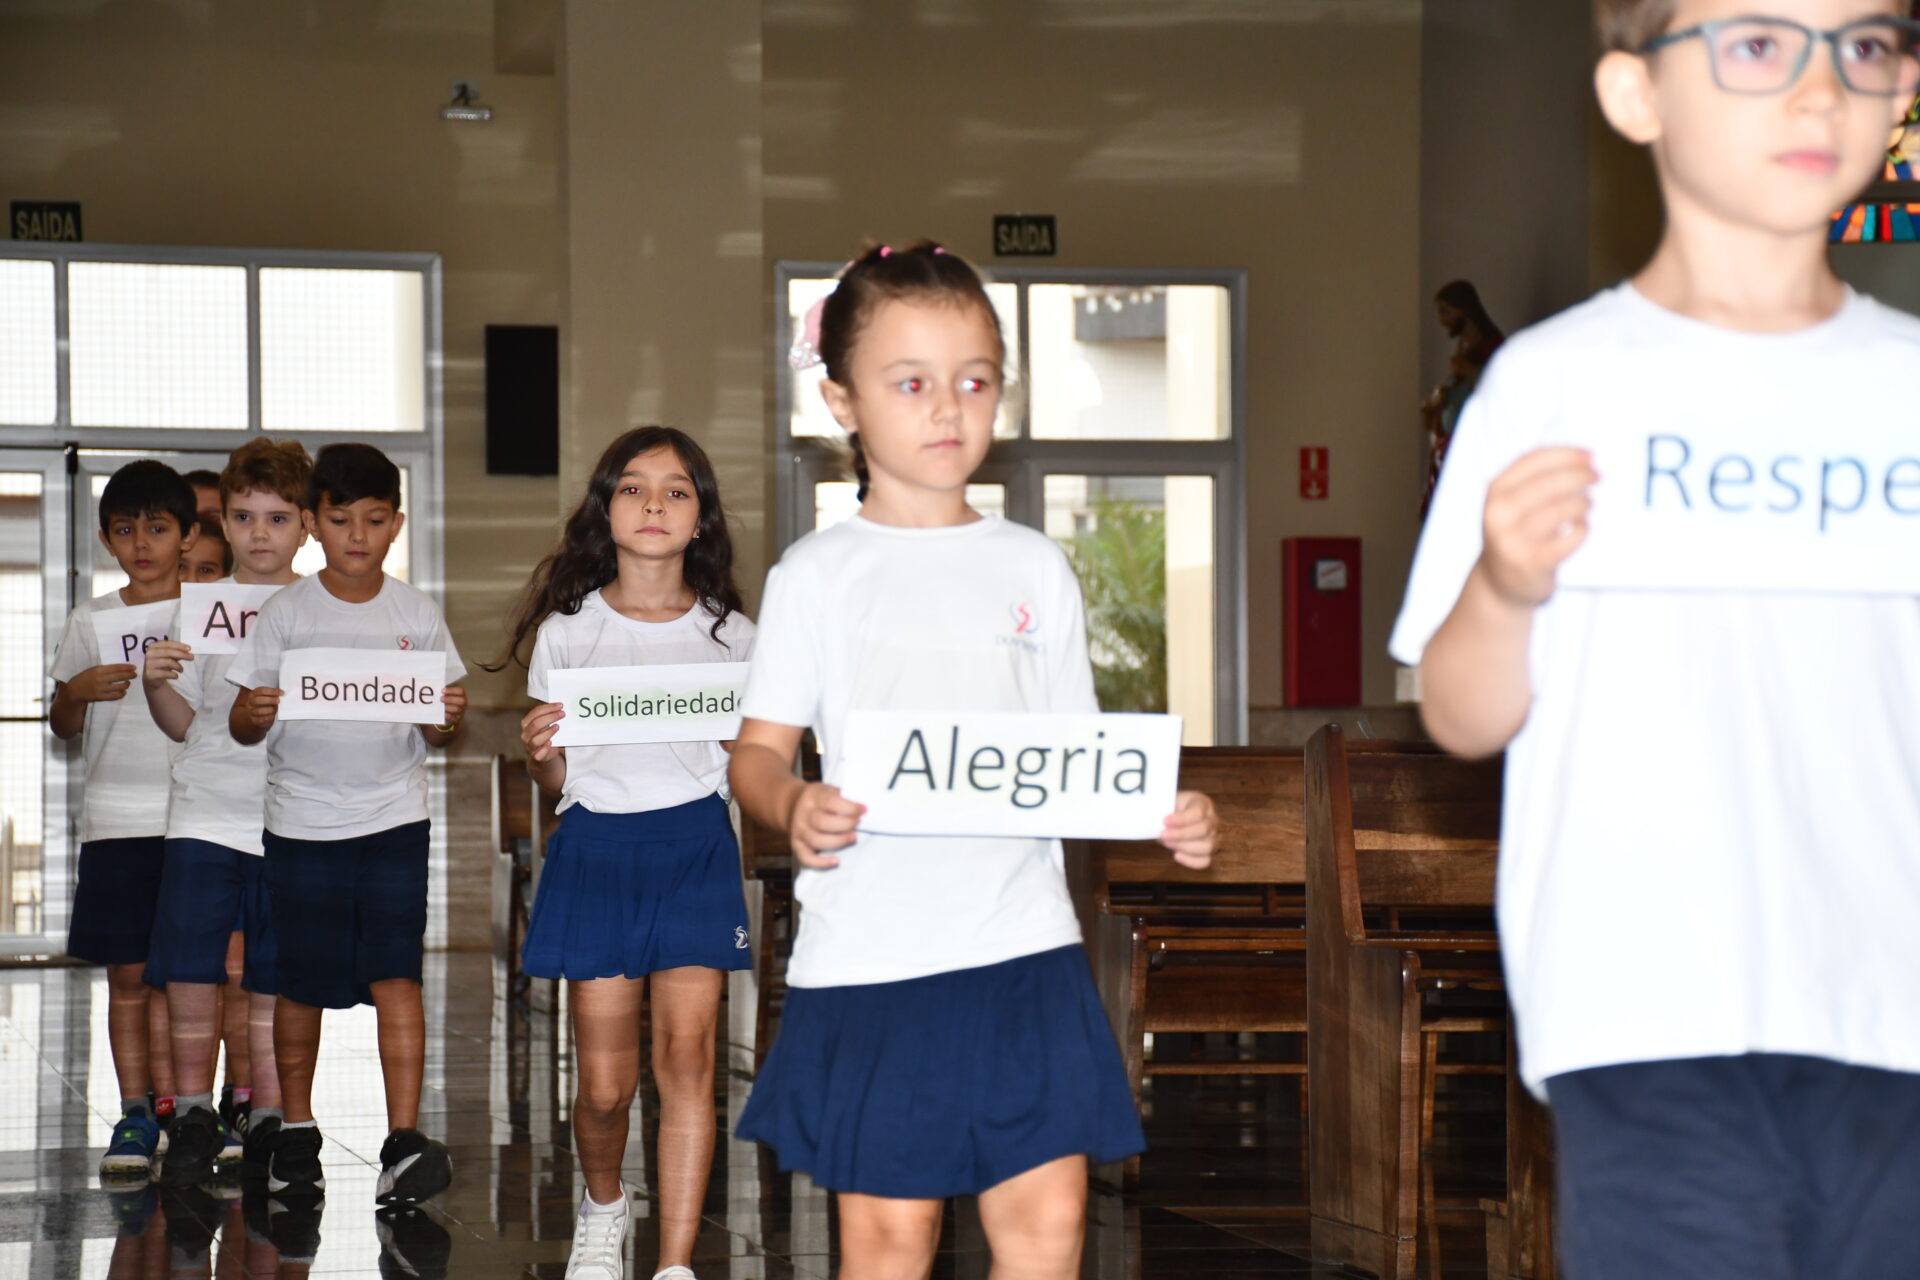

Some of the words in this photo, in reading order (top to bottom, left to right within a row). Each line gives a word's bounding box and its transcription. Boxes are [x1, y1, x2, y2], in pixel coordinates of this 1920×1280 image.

[1644, 432, 1920, 533] Respe
[121, 633, 169, 662] Pe
[301, 675, 435, 705] Bondade
[887, 725, 1147, 809] Alegria
